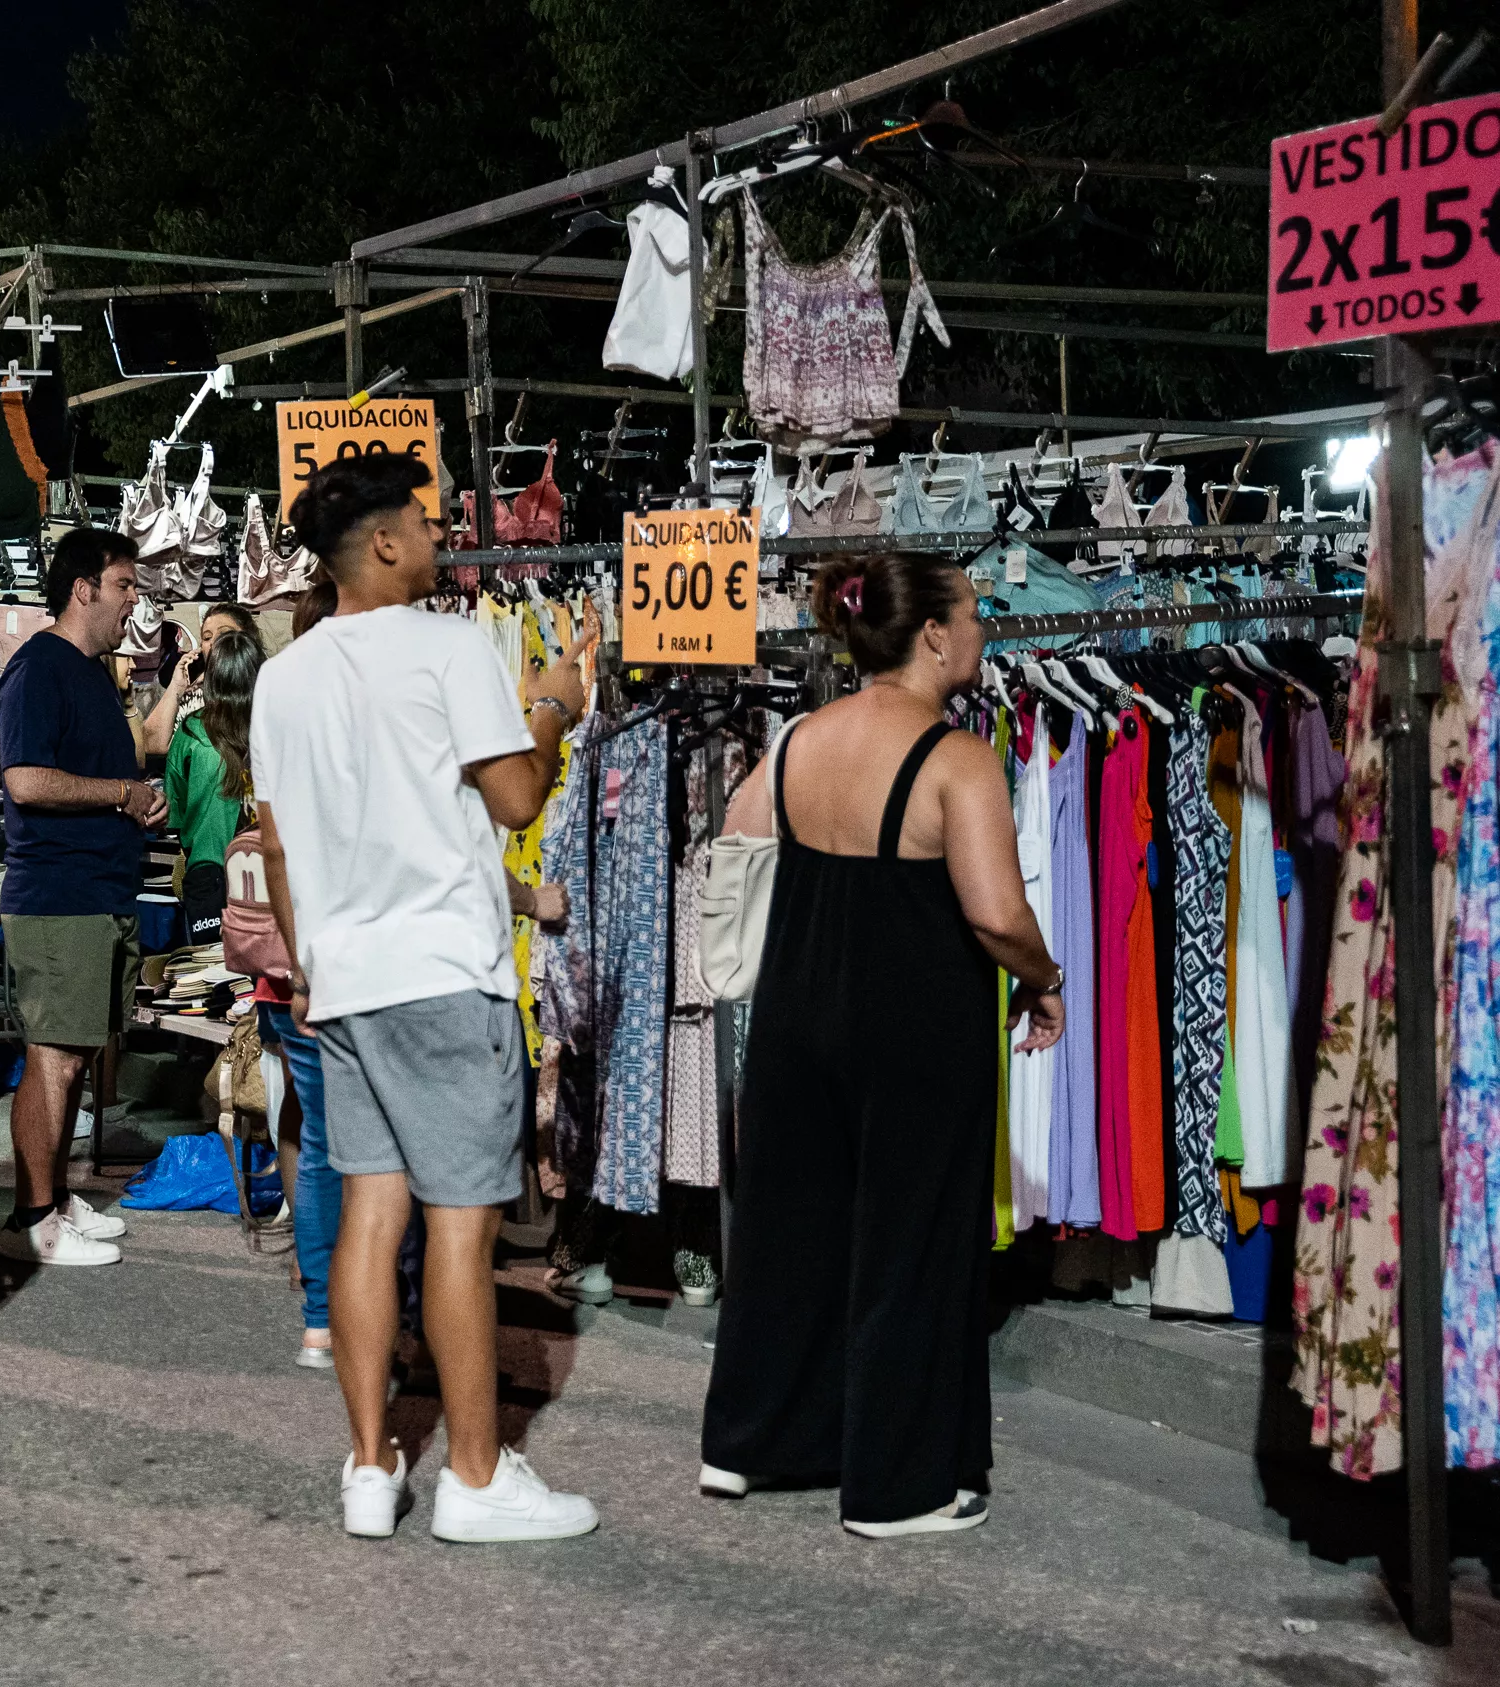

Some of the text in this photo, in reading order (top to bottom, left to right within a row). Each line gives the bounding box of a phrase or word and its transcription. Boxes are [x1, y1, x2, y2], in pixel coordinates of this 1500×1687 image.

[1333, 286, 1446, 328] TODOS
[287, 403, 429, 431] LIQUIDACIÓN
[630, 513, 753, 549] LIQUIDACIÓN
[632, 560, 748, 620] 5,00 €
[670, 636, 700, 652] R&M
